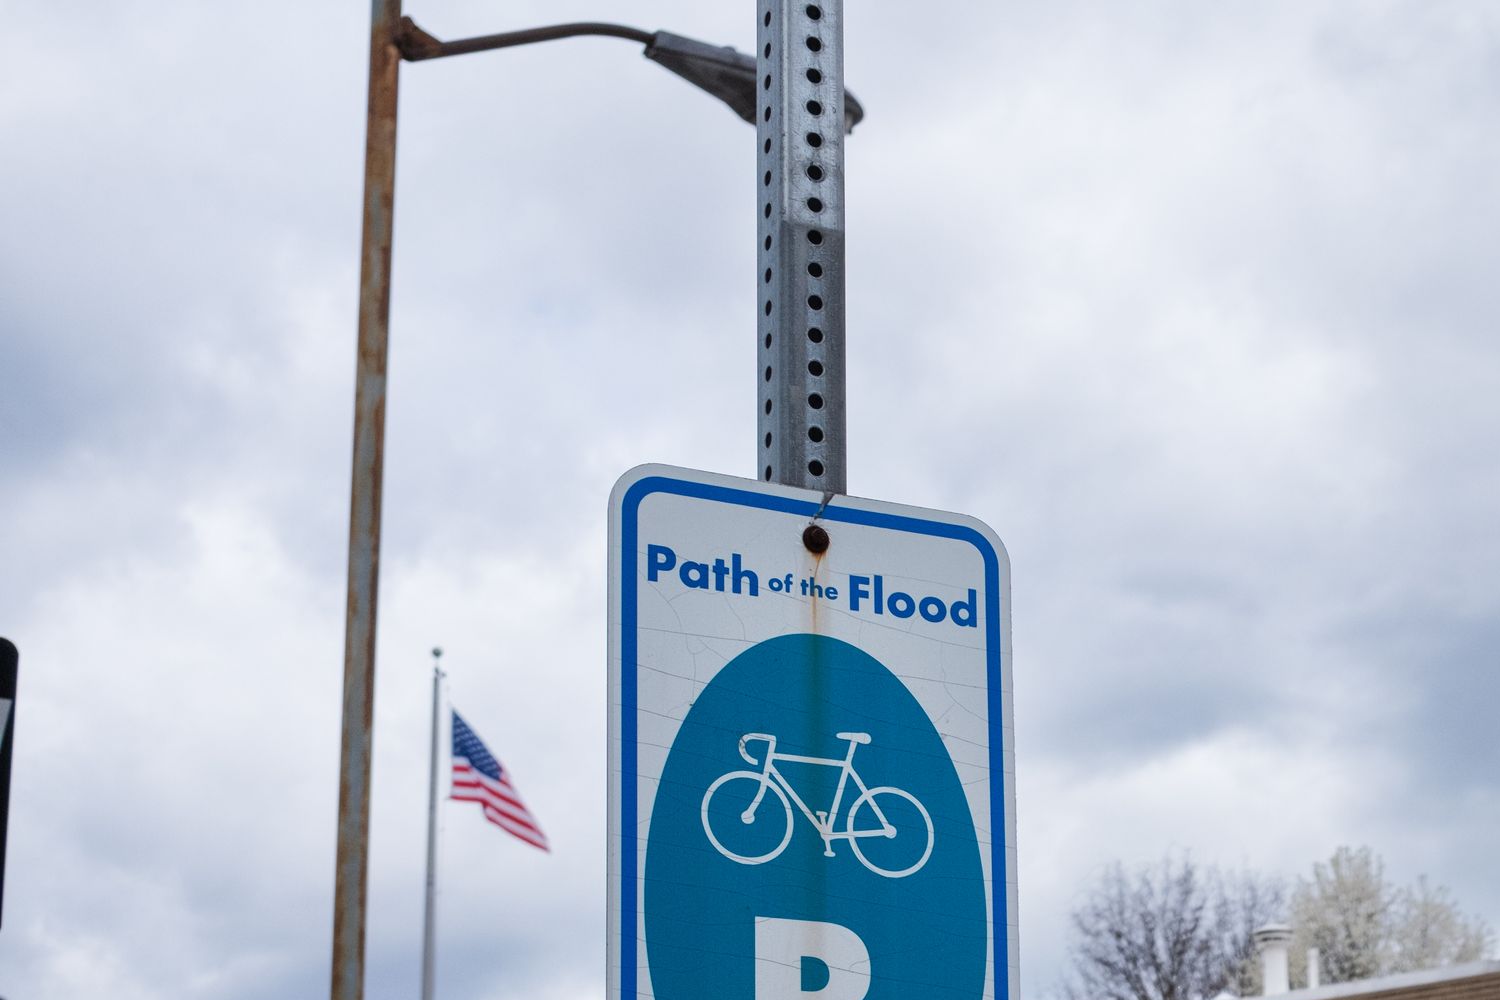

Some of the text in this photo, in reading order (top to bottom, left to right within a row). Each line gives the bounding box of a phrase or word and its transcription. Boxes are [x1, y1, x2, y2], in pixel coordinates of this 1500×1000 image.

[646, 543, 979, 629] Path of the Flood
